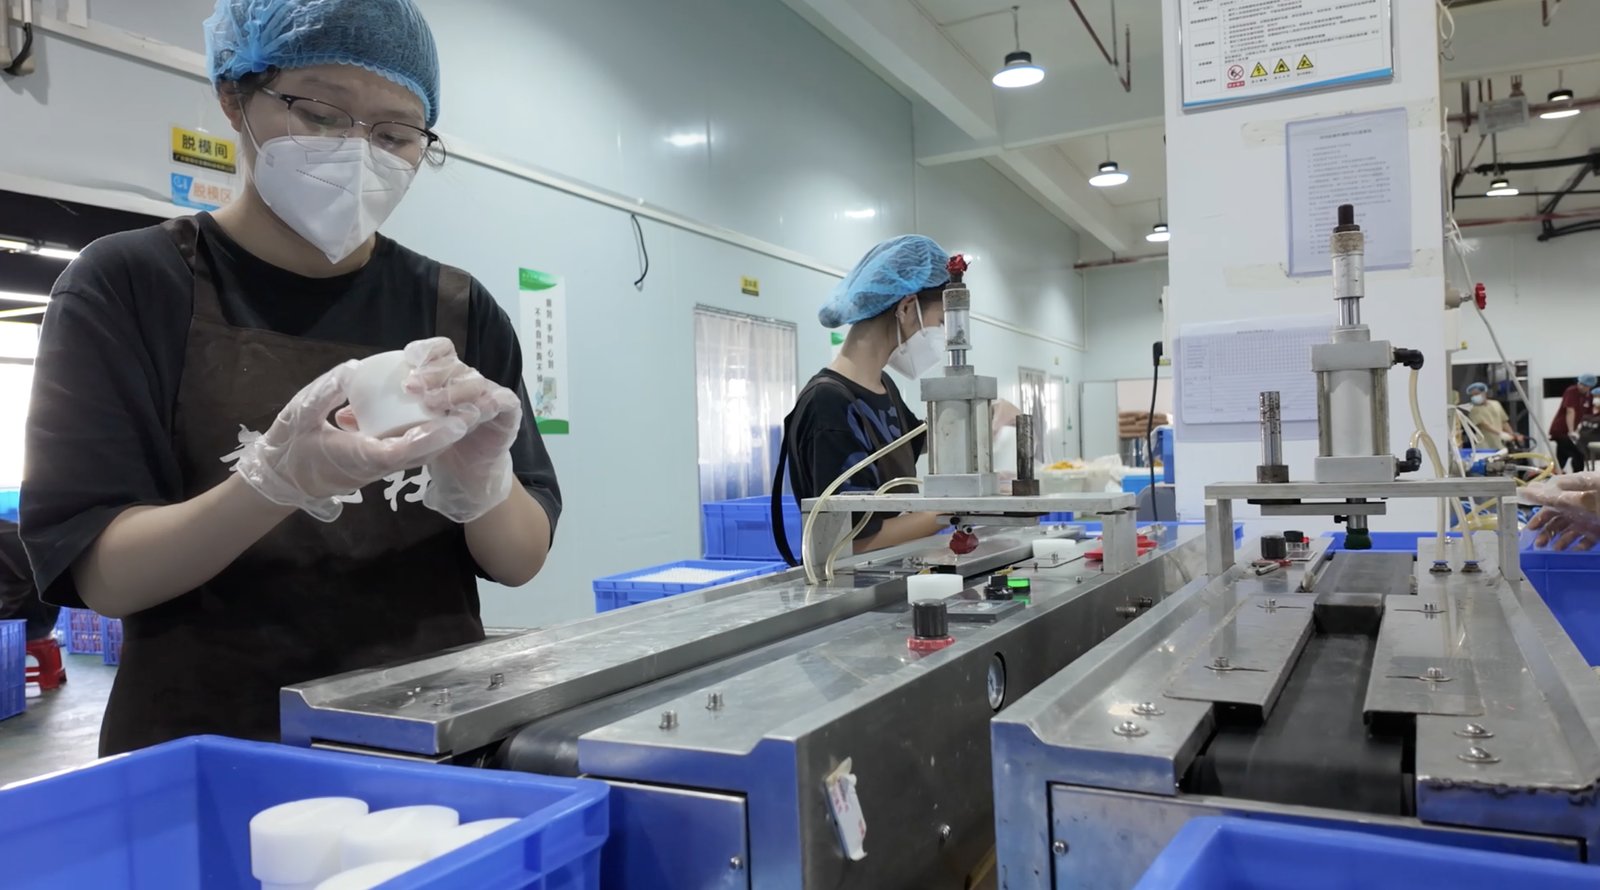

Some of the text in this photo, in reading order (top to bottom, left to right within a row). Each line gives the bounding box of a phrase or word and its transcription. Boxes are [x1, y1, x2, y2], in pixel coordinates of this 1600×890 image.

[183, 134, 228, 159] 脱模间
[194, 182, 231, 202] 脱模区
